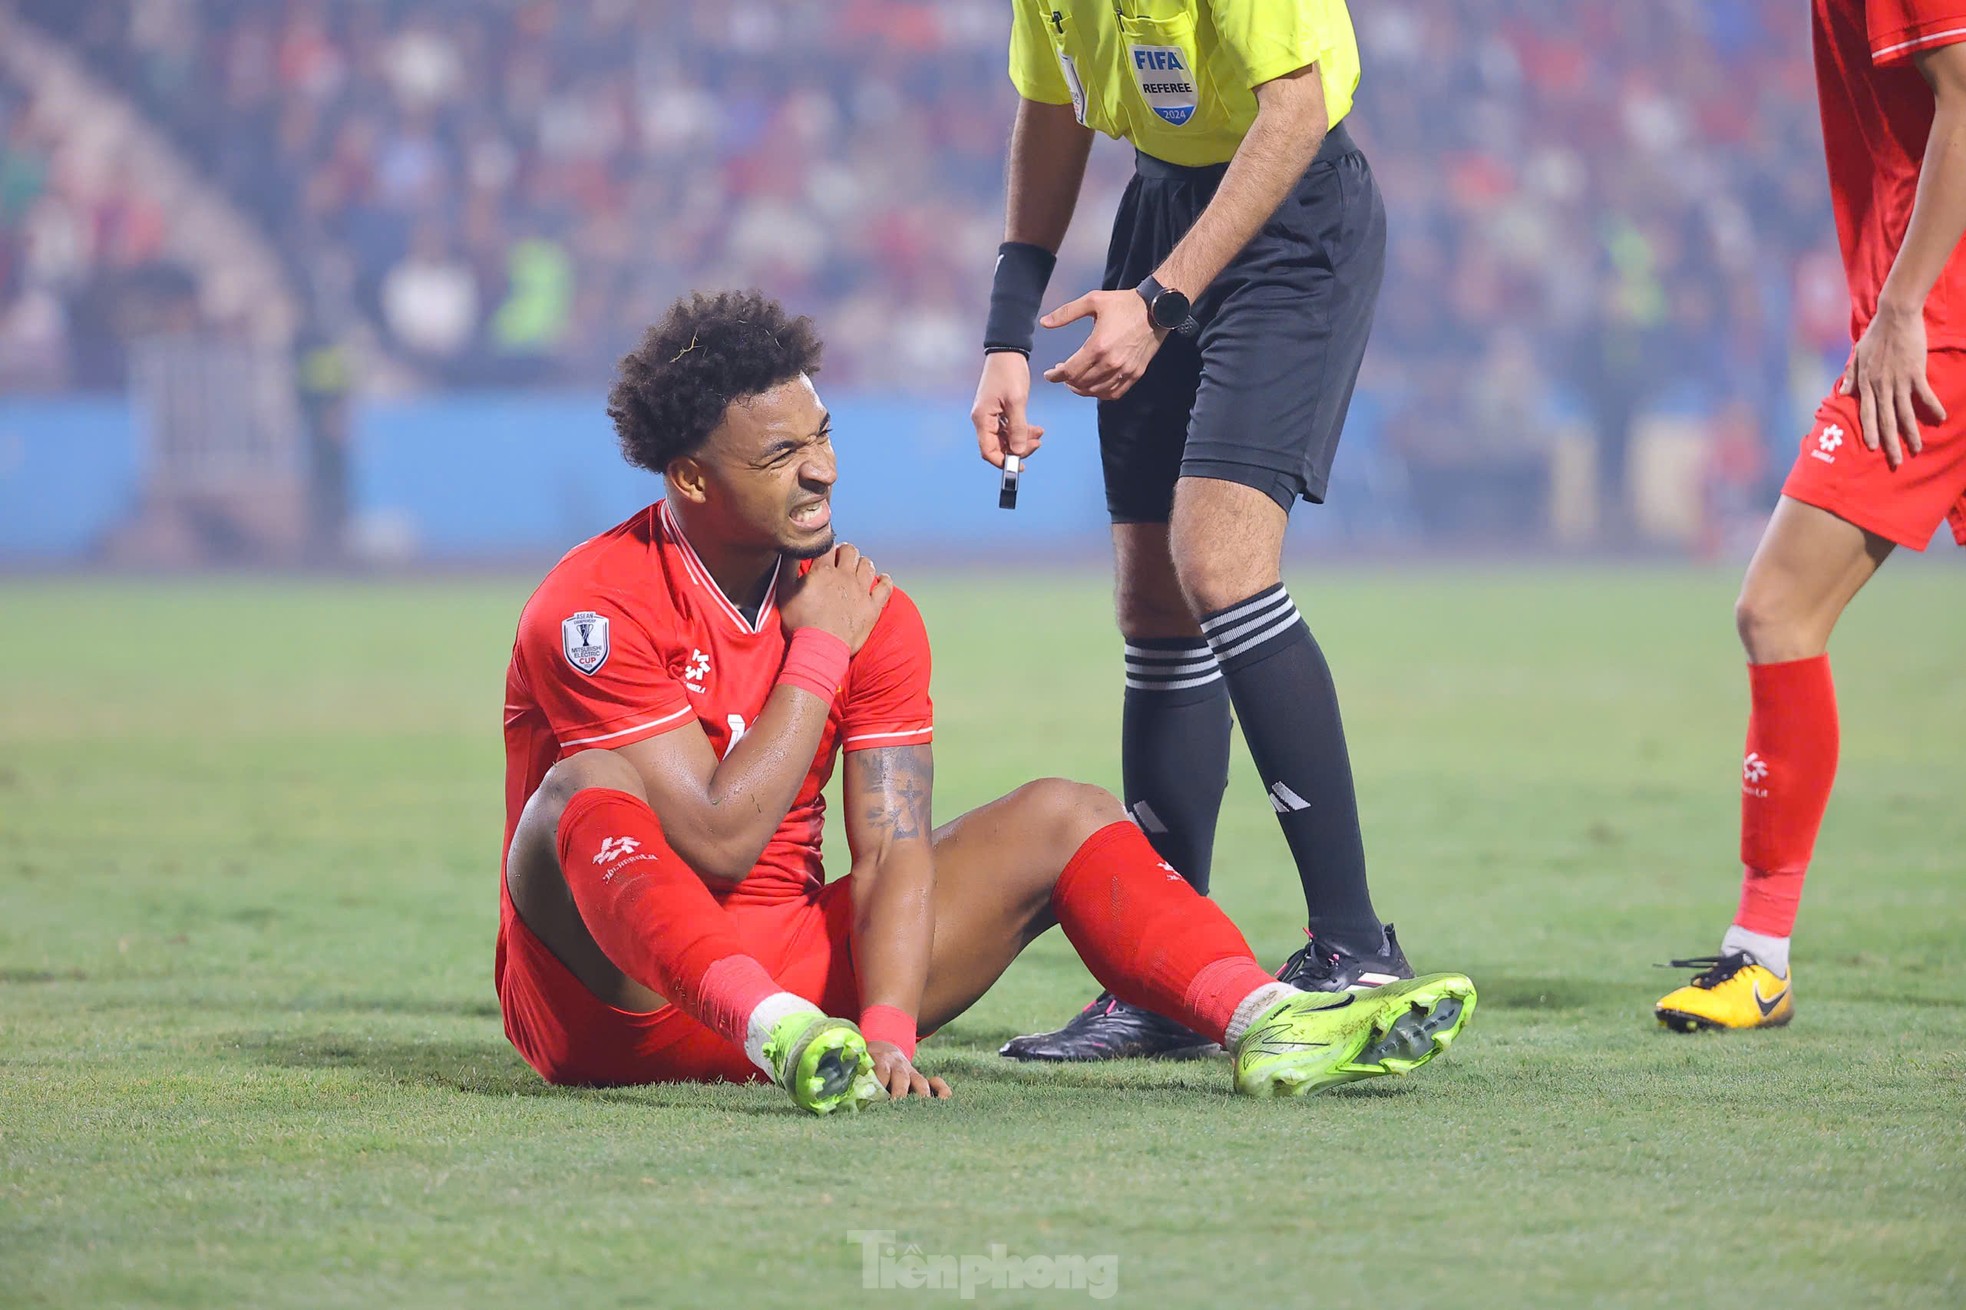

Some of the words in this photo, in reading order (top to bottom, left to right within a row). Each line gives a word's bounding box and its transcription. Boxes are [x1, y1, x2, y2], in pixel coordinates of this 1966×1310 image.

[1134, 50, 1184, 70] FIFA
[1143, 83, 1193, 94] REFEREE
[1163, 110, 1186, 120] 2024
[579, 657, 597, 665] CUP
